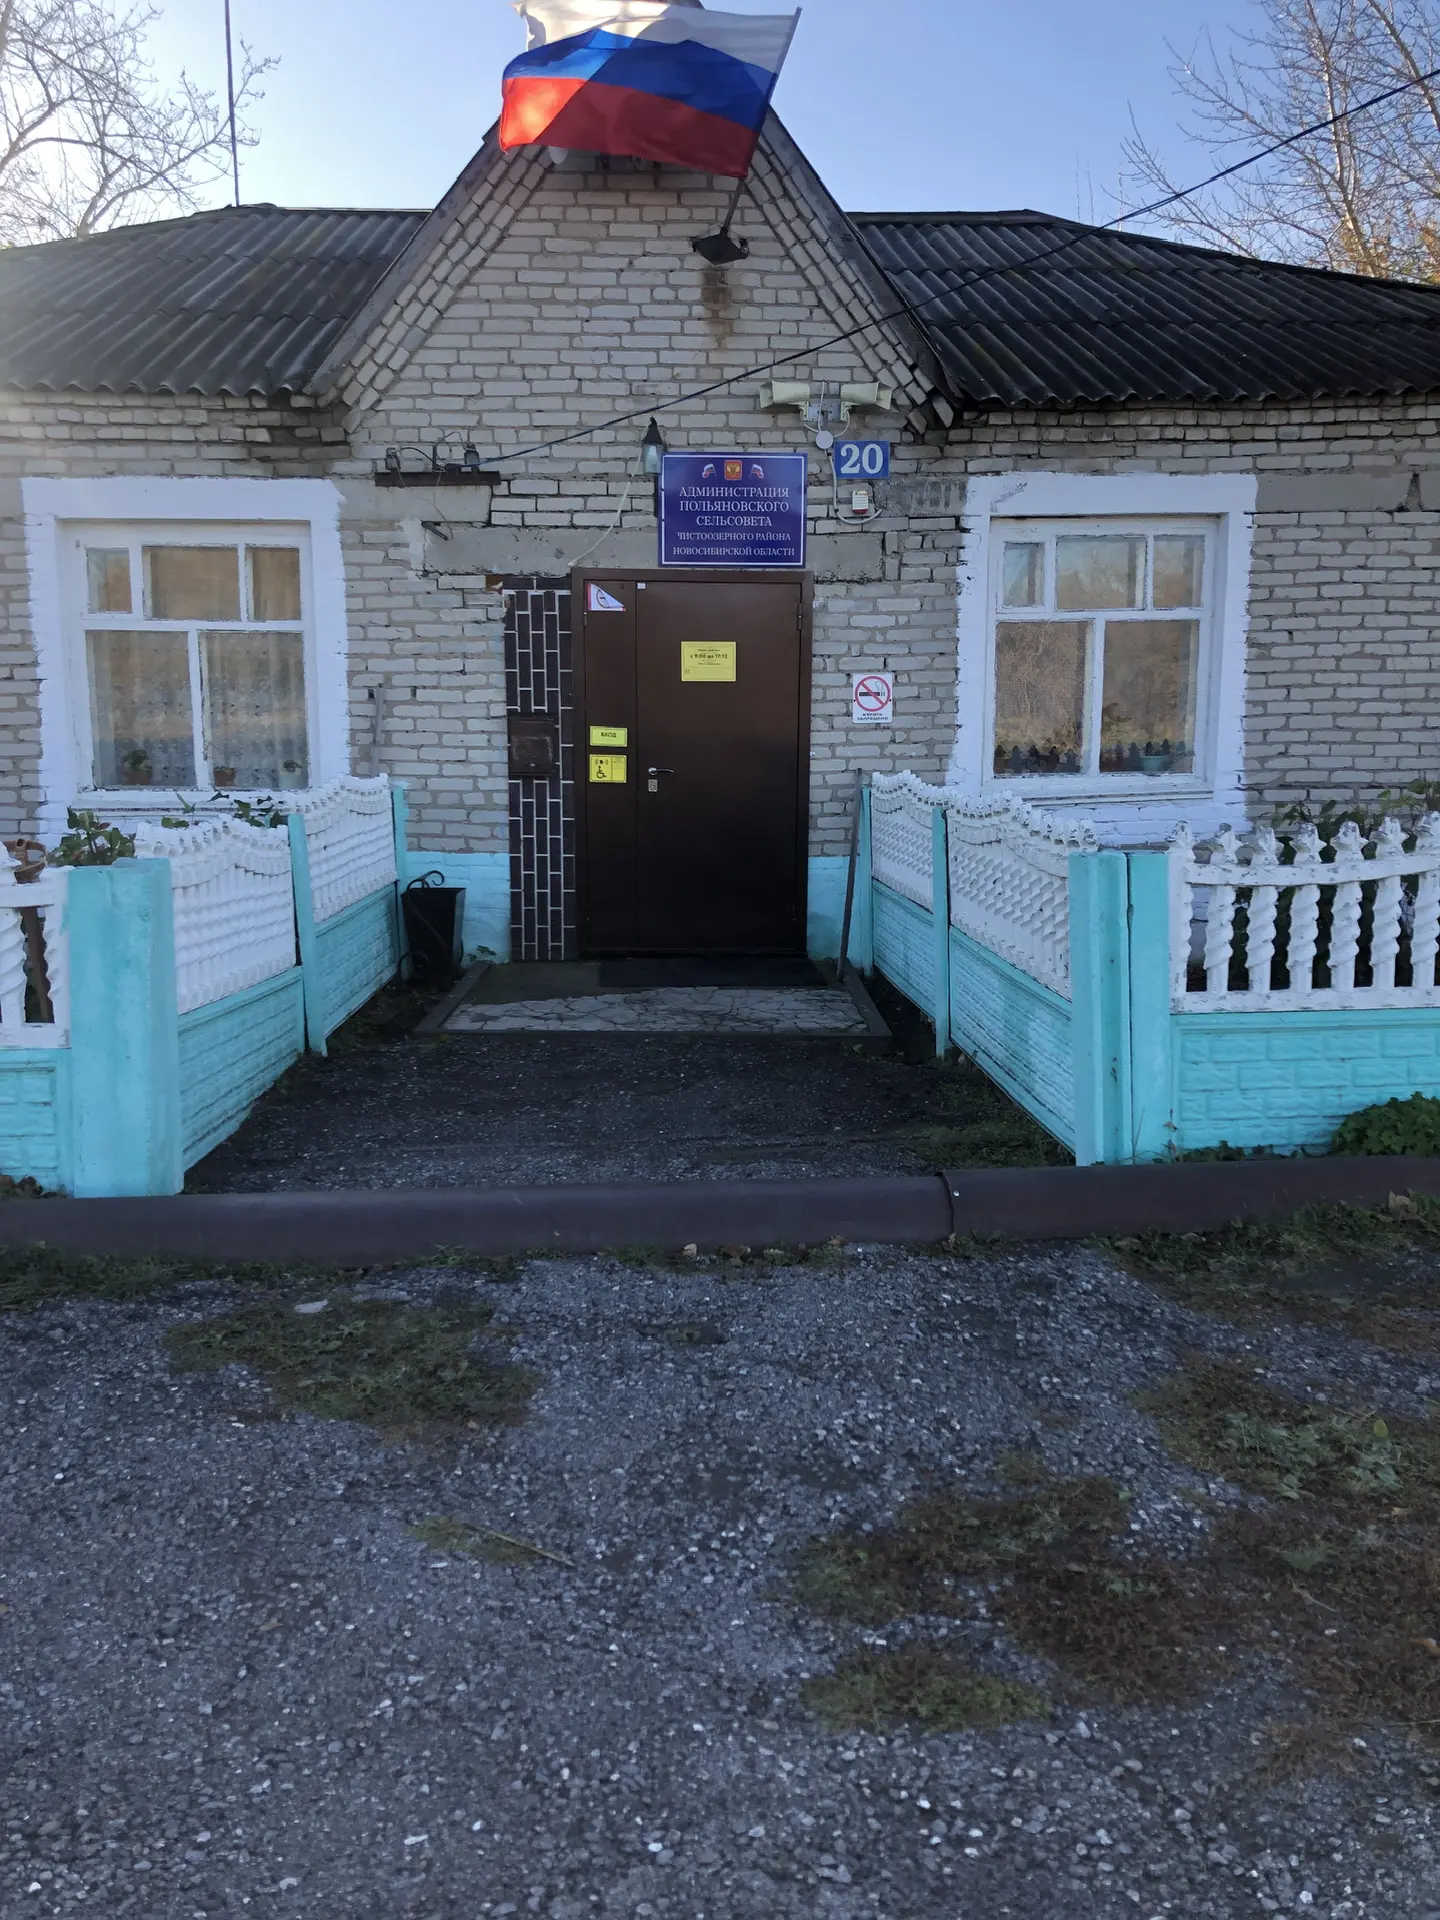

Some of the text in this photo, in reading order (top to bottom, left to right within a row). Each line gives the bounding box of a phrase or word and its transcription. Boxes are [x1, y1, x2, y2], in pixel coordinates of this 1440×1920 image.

[840, 443, 884, 474] 20
[679, 486, 789, 498] АДМИНИСТРАЦИЯ
[680, 500, 789, 512] ПОЛЬЯНОВСКОГО
[696, 516, 772, 526] СЕЛЬСОВЕТА
[677, 532, 791, 541] ЧИСТООЗЕРНОГО РАЙОНА
[673, 546, 795, 556] НОВОСИБИРСКОЙ ОБЛАСТИ
